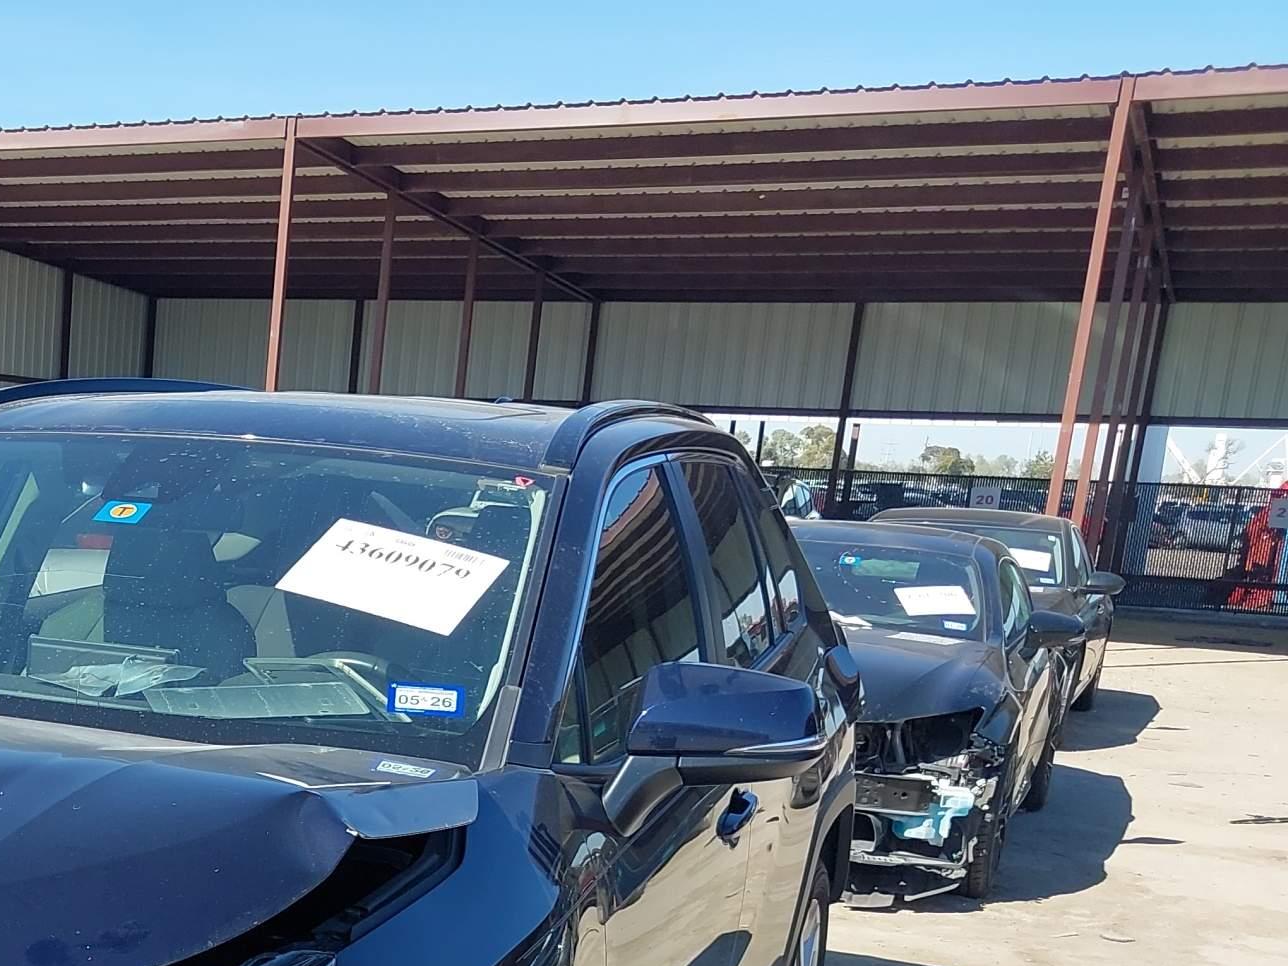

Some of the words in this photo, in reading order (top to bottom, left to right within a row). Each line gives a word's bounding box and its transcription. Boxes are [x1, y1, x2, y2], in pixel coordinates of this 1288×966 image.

[975, 495, 994, 505] 20
[335, 539, 471, 579] 43609079
[398, 694, 420, 706] 05
[429, 696, 453, 709] 26
